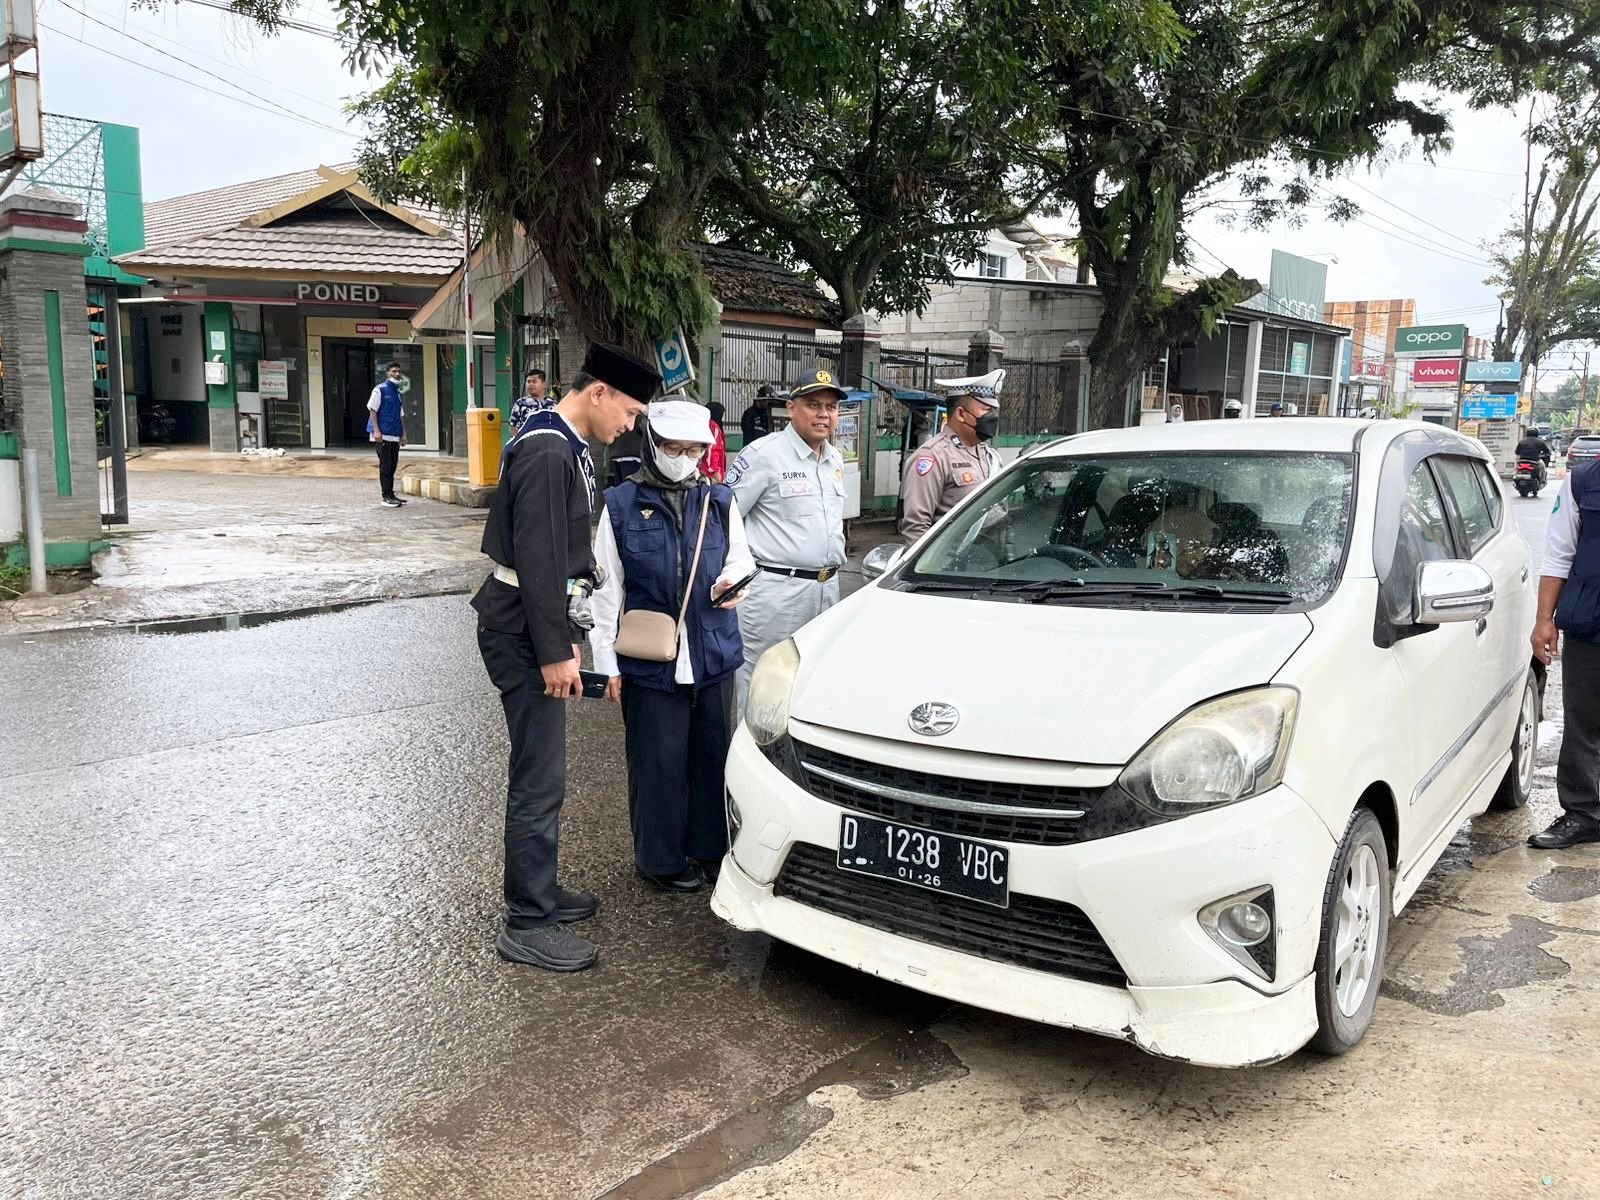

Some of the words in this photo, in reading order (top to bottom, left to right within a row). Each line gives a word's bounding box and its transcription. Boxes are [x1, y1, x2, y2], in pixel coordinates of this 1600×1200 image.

[297, 283, 380, 302] PONED
[666, 370, 690, 389] MASUK
[782, 471, 807, 480] SURYA
[843, 816, 858, 849] D
[885, 825, 941, 869] 1238
[960, 842, 1005, 885] VBC
